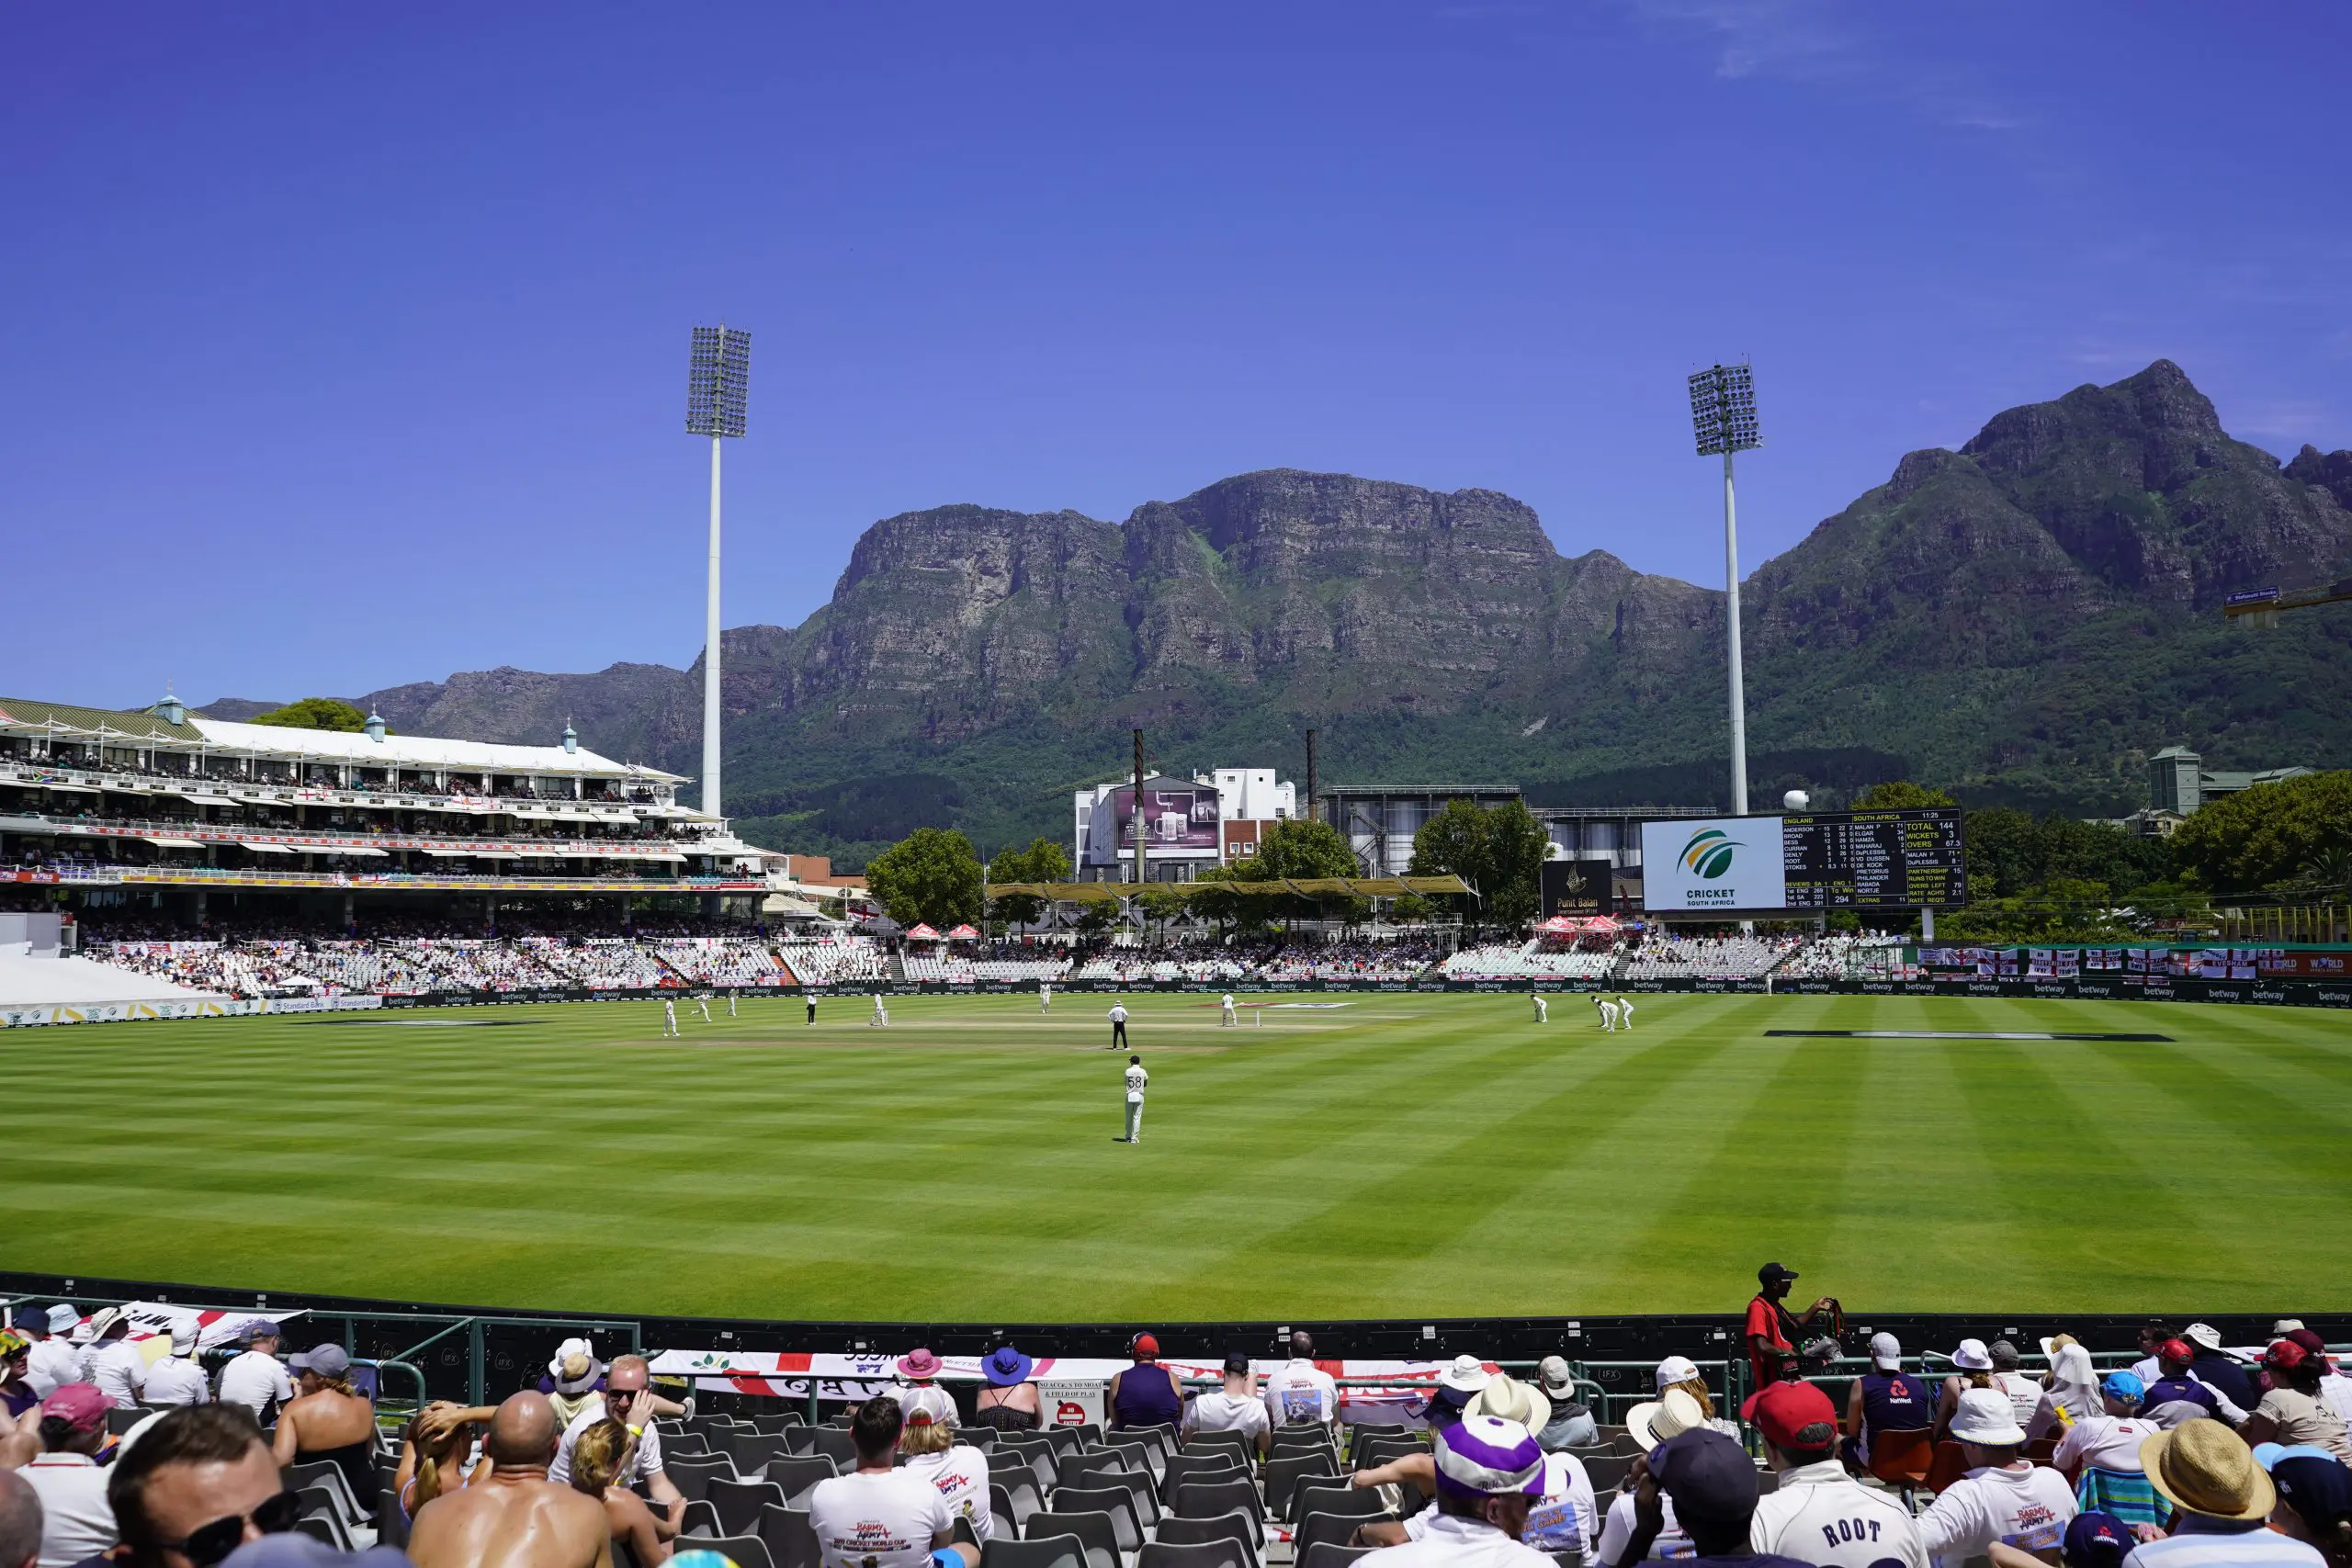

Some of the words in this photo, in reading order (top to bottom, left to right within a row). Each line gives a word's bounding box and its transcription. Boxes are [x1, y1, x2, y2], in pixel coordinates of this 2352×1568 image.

[1687, 889, 1735, 898] CRICKET
[1558, 898, 1576, 907] Punit
[1578, 898, 1598, 907] Balan
[893, 985, 919, 993] betway
[950, 984, 975, 992] betway
[986, 984, 1012, 992] betway
[1182, 982, 1206, 990] betway
[1237, 982, 1261, 990] betway
[1272, 982, 1297, 990] betway
[1325, 982, 1351, 990] betway
[1419, 982, 1444, 990] betway
[1476, 982, 1502, 990] betway
[1534, 981, 1562, 989] betway
[1574, 981, 1601, 989] betway
[1634, 981, 1662, 989] betway
[1696, 982, 1724, 990] betway
[1737, 982, 1766, 990] betway
[1800, 982, 1829, 992] betway
[1863, 983, 1893, 992] betway
[1905, 983, 1935, 992] betway
[1969, 983, 1999, 993] betway
[745, 987, 771, 995] betway
[2035, 985, 2065, 994] betway
[2078, 986, 2109, 995] betway
[2144, 987, 2175, 997] betway
[502, 993, 527, 1001] betway
[538, 992, 564, 1000] betway
[2209, 989, 2239, 999] betway
[2253, 991, 2284, 1001] betway
[2319, 992, 2350, 1002] betway
[365, 998, 379, 1006] Bank
[446, 995, 471, 1004] betway
[284, 1001, 311, 1010] Standard
[1128, 1077, 1142, 1089] 58
[1602, 1370, 1616, 1378] IFX
[2018, 1506, 2045, 1518] BARMY
[856, 1522, 883, 1530] BARMY
[2019, 1516, 2044, 1530] ARMY
[856, 1530, 881, 1540] ARMY
[1822, 1517, 1880, 1548] ROOT
